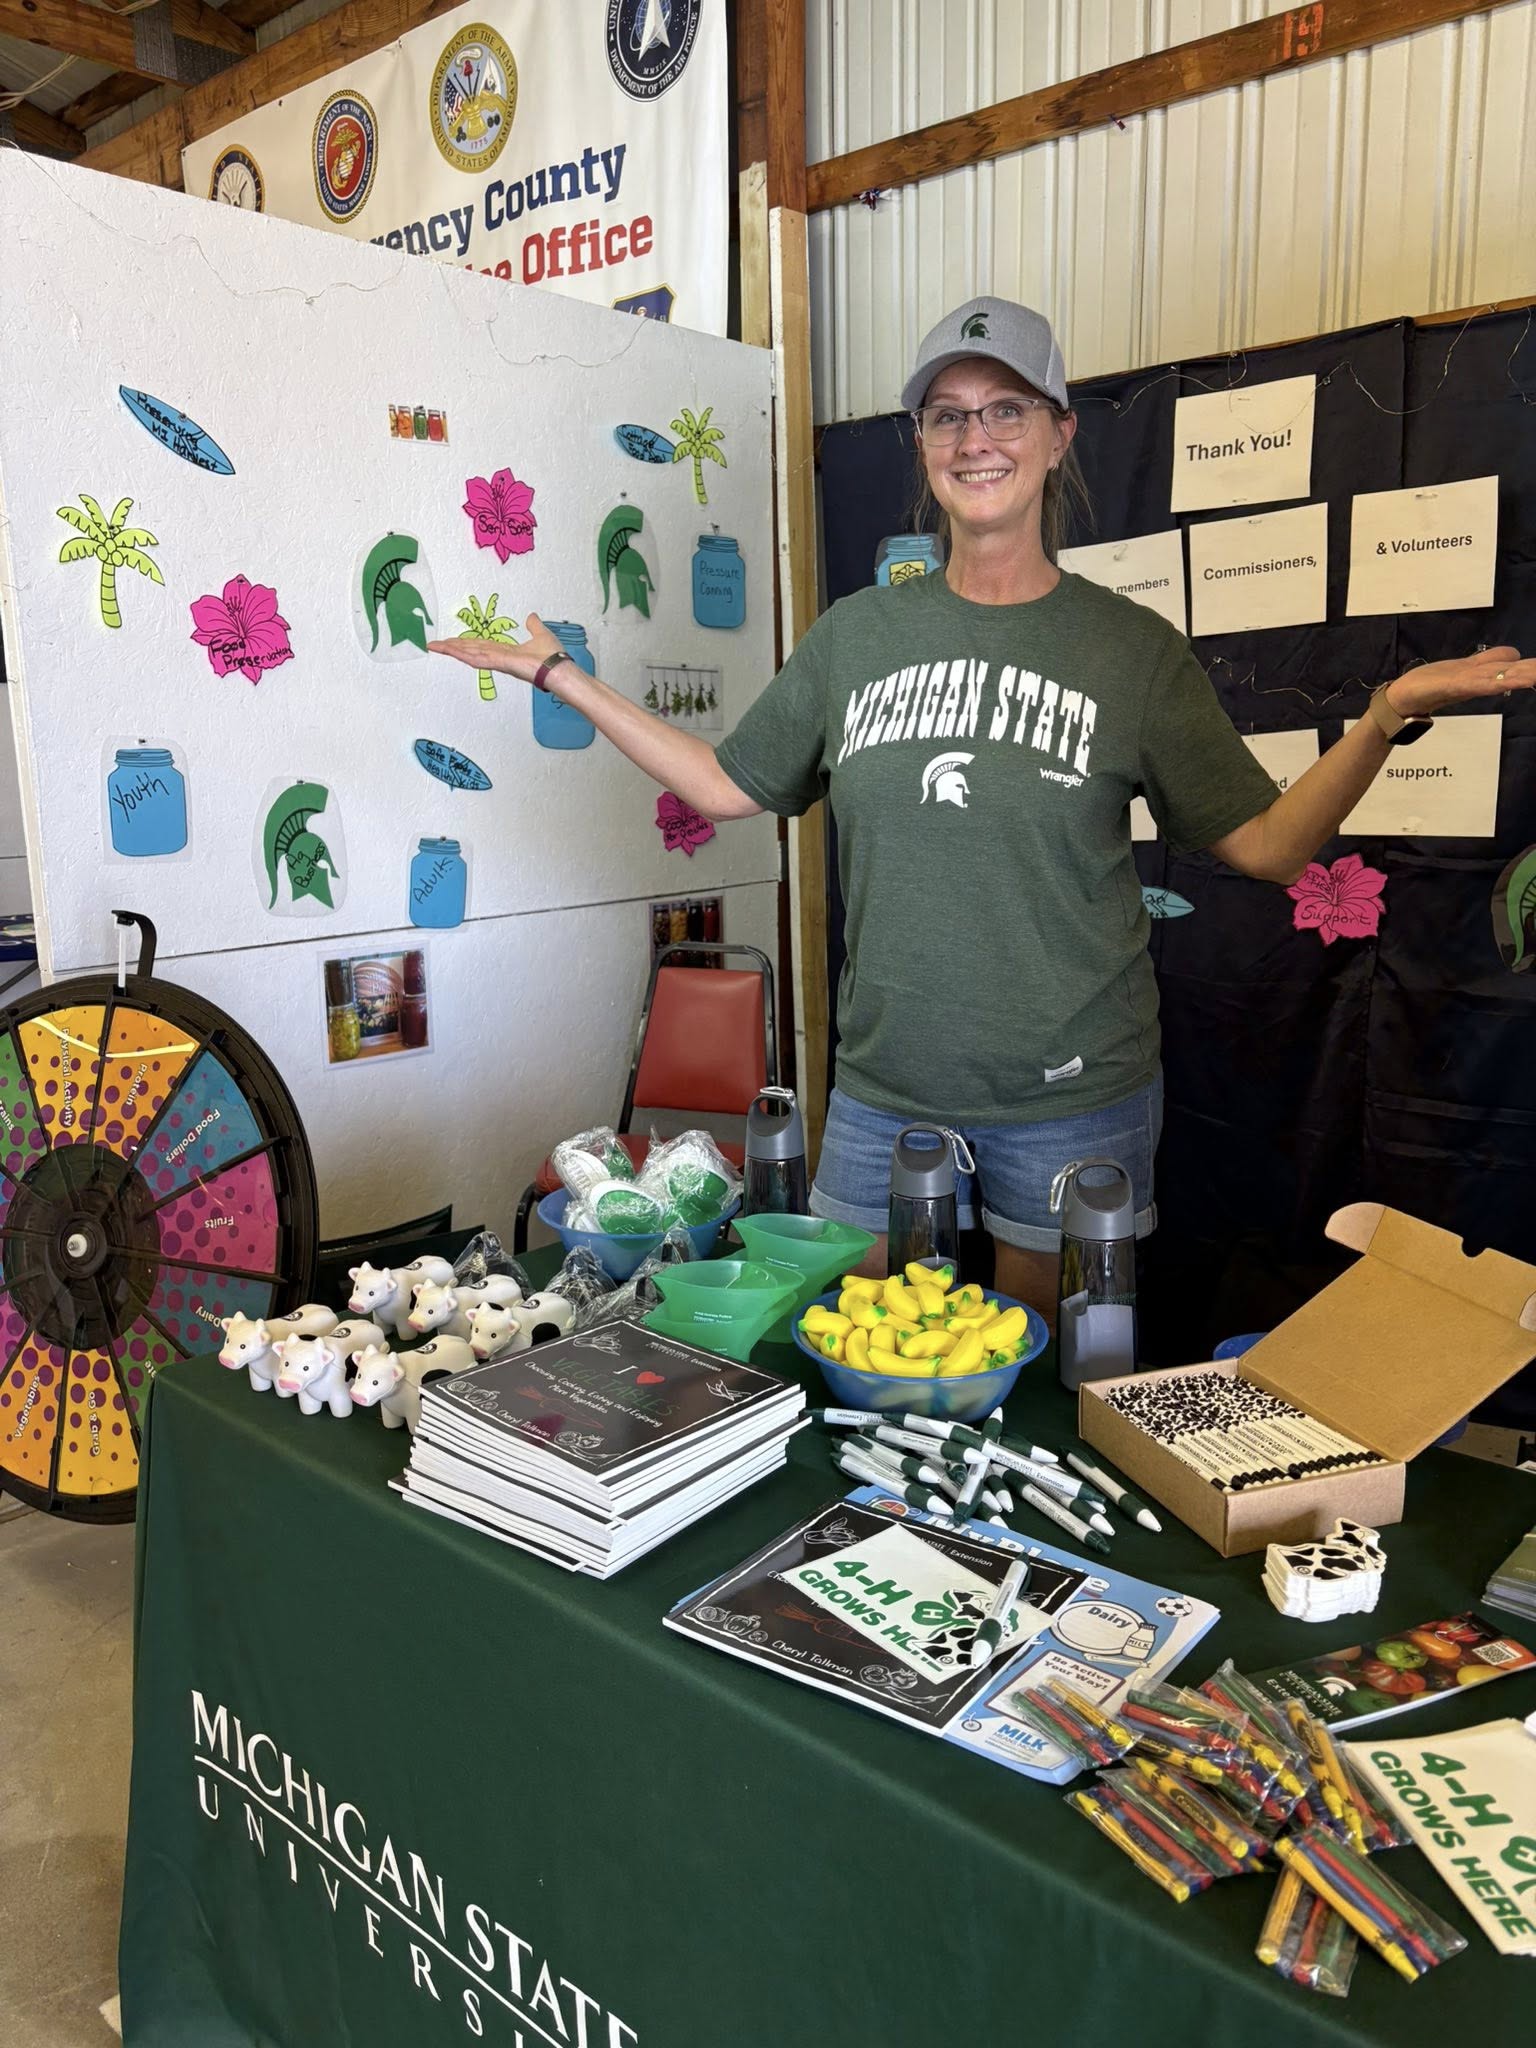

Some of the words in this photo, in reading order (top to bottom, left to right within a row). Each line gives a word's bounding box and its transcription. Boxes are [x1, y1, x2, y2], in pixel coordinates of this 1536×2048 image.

[610, 48, 647, 95] DEPARTMENT
[648, 84, 658, 95] OF
[659, 70, 674, 89] THE
[674, 54, 687, 74] AIR
[684, 12, 698, 53] FORCE
[433, 34, 465, 106] DEPARTMENT
[468, 30, 477, 40] OF
[480, 30, 493, 47] THE
[495, 46, 515, 78] ARMY
[318, 103, 341, 167] DEPARTMENT
[434, 118, 454, 157] UNITED
[456, 154, 489, 167] STATES
[489, 147, 499, 159] OF
[498, 87, 515, 146] AMERICA
[484, 144, 626, 231] County
[523, 215, 653, 285] Office
[1186, 438, 1245, 461] Thank
[1250, 429, 1292, 451] You!
[1376, 541, 1387, 555] &
[1391, 535, 1473, 553] Volunteers
[700, 560, 741, 580] Pressure
[1203, 556, 1317, 581] Commissioners,
[700, 582, 733, 603] Canning
[1116, 578, 1170, 594] members
[210, 639, 246, 658] Food
[837, 658, 989, 768] MICHIGAN
[988, 664, 1098, 778] STATE
[426, 741, 446, 762] Safe
[1040, 768, 1085, 789] Wrangler
[1386, 766, 1453, 780] support.
[112, 772, 170, 823] Youth
[1300, 904, 1371, 928] Support
[62, 1028, 72, 1077] Physical
[126, 1063, 148, 1106] Protein
[64, 1081, 73, 1127] Activity
[195, 1109, 221, 1134] Food
[165, 1132, 196, 1164] Dollars
[204, 1216, 234, 1229] Fruits
[195, 1306, 222, 1328] Dairy
[613, 1365, 638, 1375] I
[14, 1375, 40, 1438] Vegetables
[88, 1391, 96, 1409] Go
[570, 1393, 608, 1414] Vegetables
[90, 1413, 97, 1422] &
[496, 1410, 523, 1424] Cheryl
[614, 1402, 630, 1413] and
[630, 1408, 663, 1428] Enjoying
[91, 1425, 100, 1456] Grab
[1036, 1472, 1065, 1489] Extension
[925, 1540, 946, 1550] STATE
[950, 1549, 993, 1567] Extension
[833, 1561, 913, 1606] 4-H
[798, 1570, 887, 1626] GROWS
[1088, 1606, 1132, 1629] Dairy
[1128, 1638, 1150, 1649] MILK
[771, 1640, 807, 1659] Cheryl
[810, 1653, 854, 1677] Tallman
[1051, 1656, 1068, 1666] Be
[1070, 1662, 1111, 1683] Active
[1044, 1660, 1073, 1676] Your
[1075, 1673, 1108, 1690] Way!
[998, 1723, 1050, 1751] MILK
[1370, 1750, 1466, 1849] GROWS
[1421, 1752, 1514, 1827] 4-H
[191, 1690, 447, 1939] MICHIGAN
[1450, 1856, 1536, 1938] HERE
